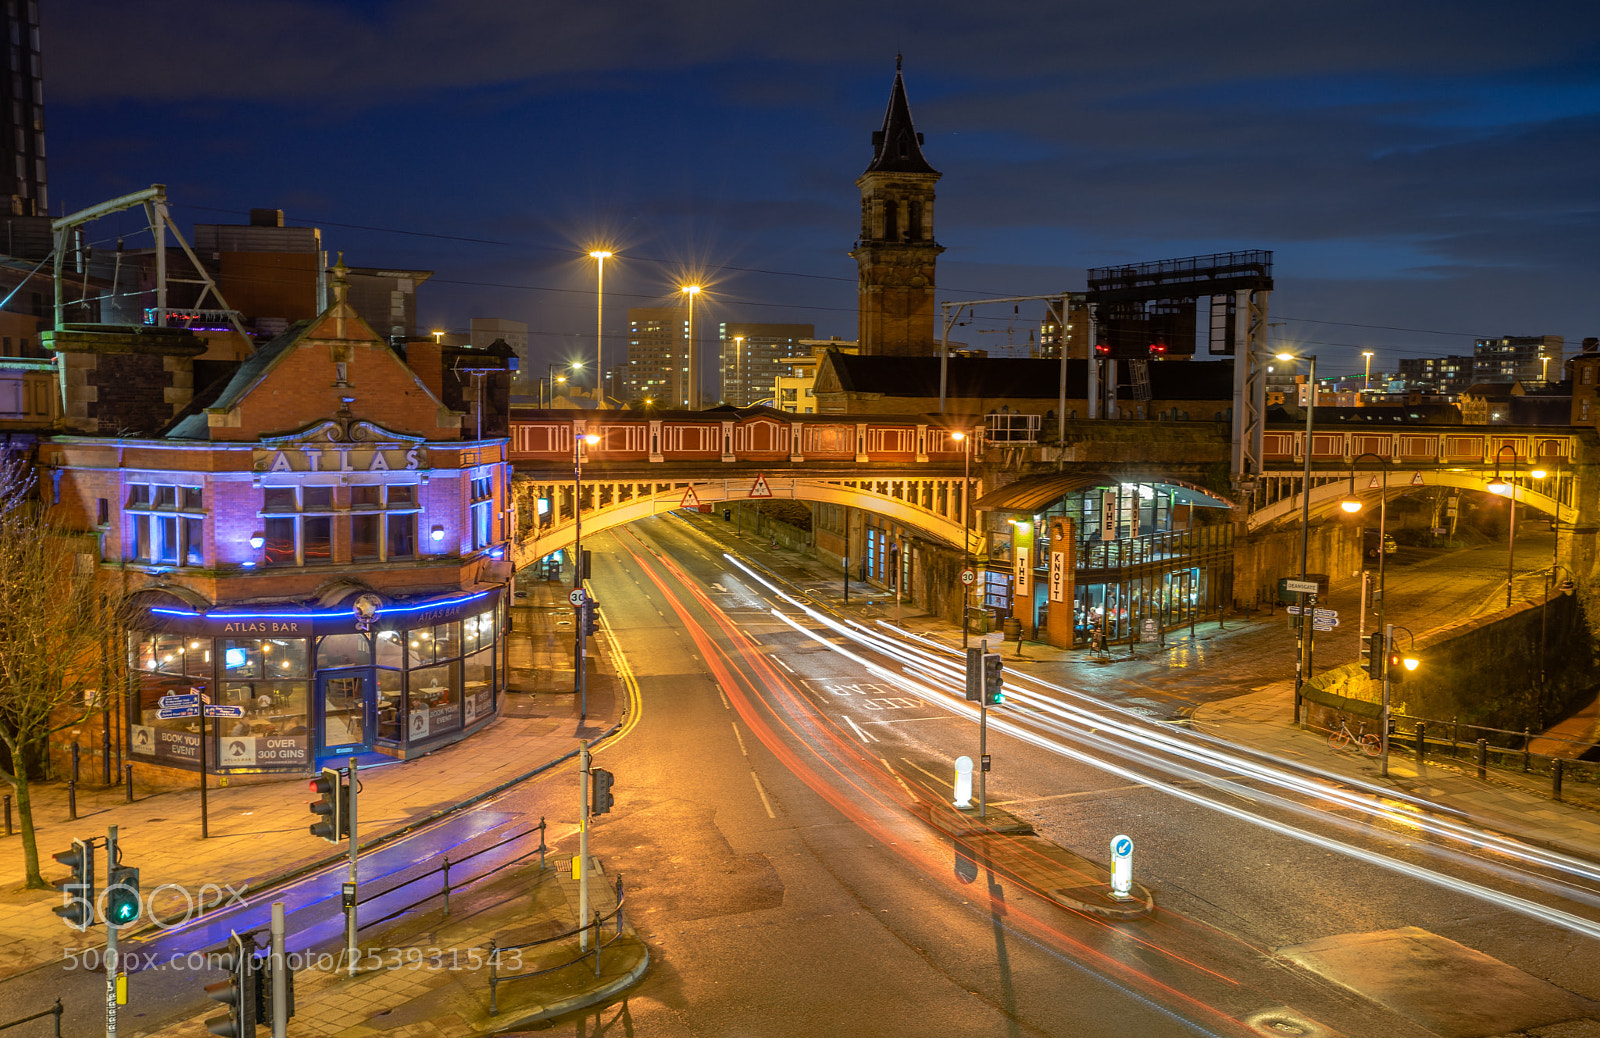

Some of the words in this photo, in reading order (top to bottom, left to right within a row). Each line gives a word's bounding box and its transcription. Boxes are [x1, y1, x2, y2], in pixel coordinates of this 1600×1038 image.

[269, 450, 419, 471] ATLAS
[1106, 502, 1114, 530] THE
[962, 573, 974, 581] 30
[571, 593, 583, 602] 30
[417, 609, 443, 622] ATLAS
[224, 622, 267, 632] ATLAS
[272, 622, 298, 632] BAR
[862, 697, 936, 710] KEEP
[161, 732, 183, 744] BOOK
[184, 735, 203, 746] YOU
[266, 739, 296, 748] OVER
[171, 744, 196, 756] EVENT
[257, 750, 276, 759] 300
[278, 749, 305, 758] GINS
